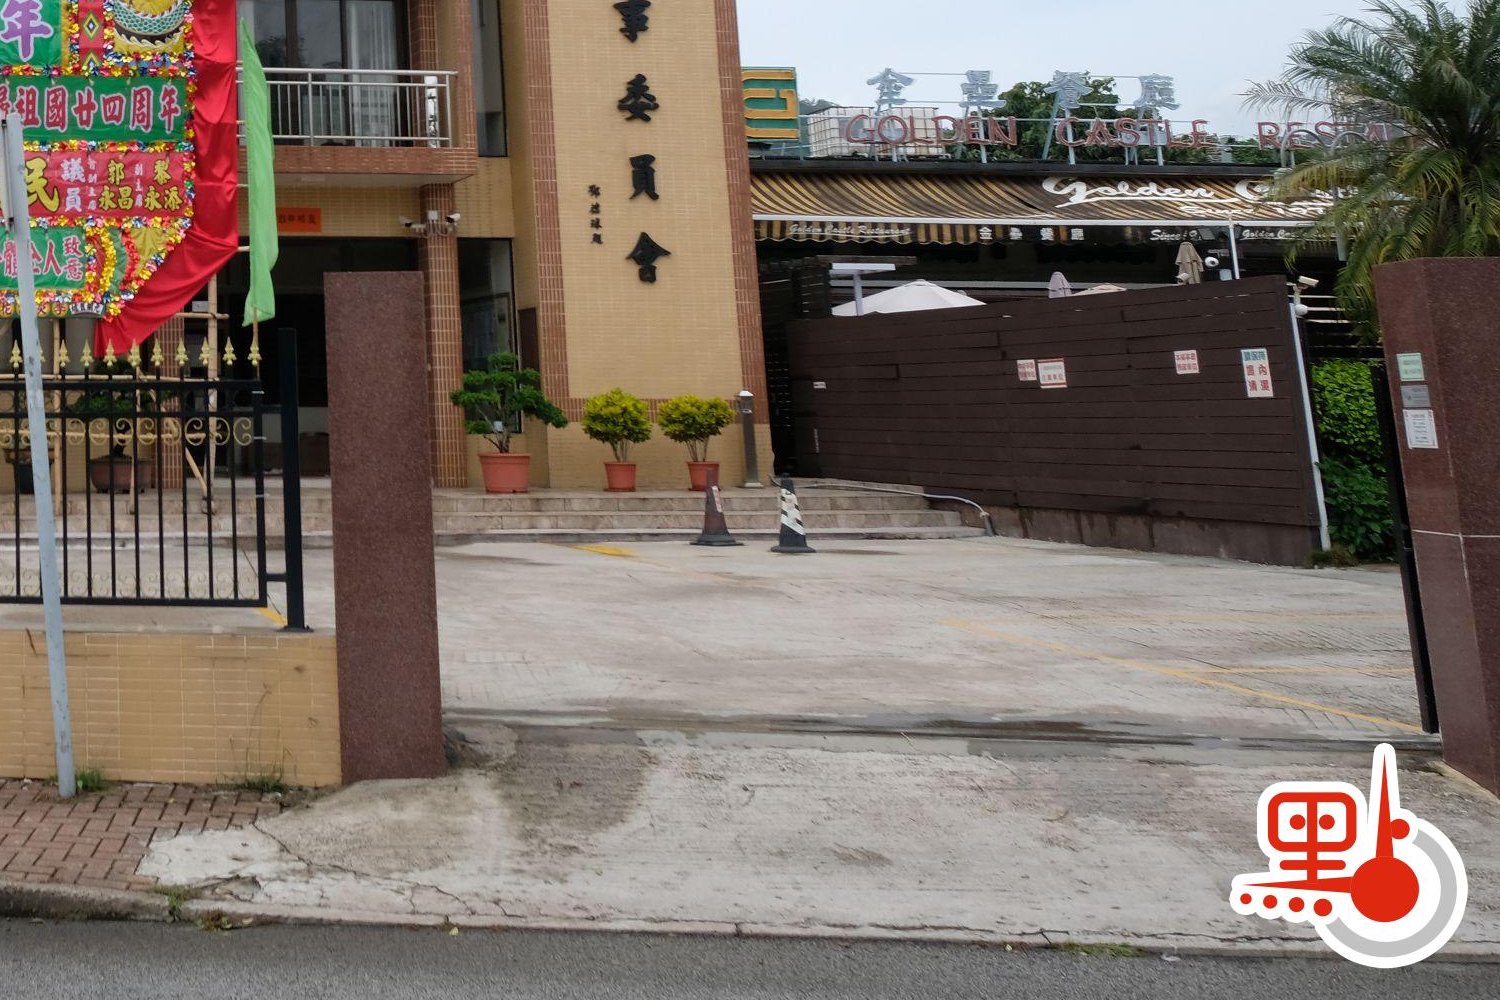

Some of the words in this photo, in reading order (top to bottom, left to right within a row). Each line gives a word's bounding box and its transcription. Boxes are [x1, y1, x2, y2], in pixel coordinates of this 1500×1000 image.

[845, 114, 1017, 146] GOLDEN
[1056, 117, 1211, 149] CASTLE
[1042, 177, 1215, 204] Golden
